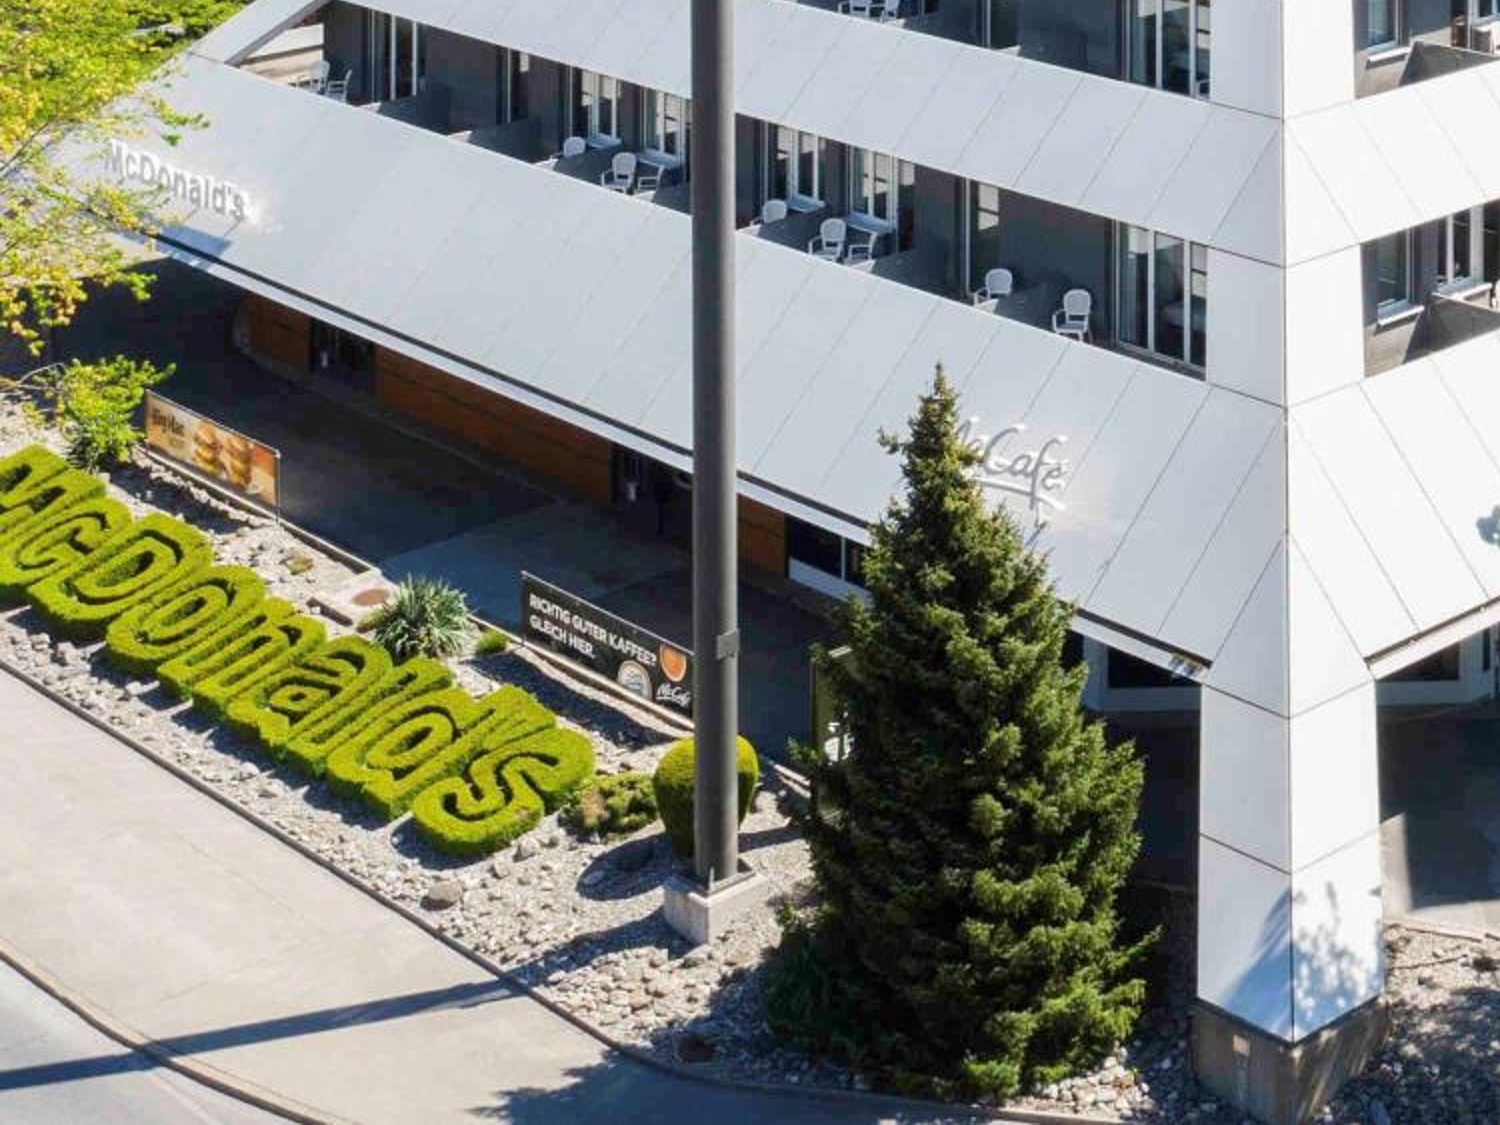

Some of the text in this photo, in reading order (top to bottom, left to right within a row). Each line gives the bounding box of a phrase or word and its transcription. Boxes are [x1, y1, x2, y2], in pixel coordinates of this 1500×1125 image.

[529, 593, 658, 668] RICHTIG GUTER KAFFEE?
